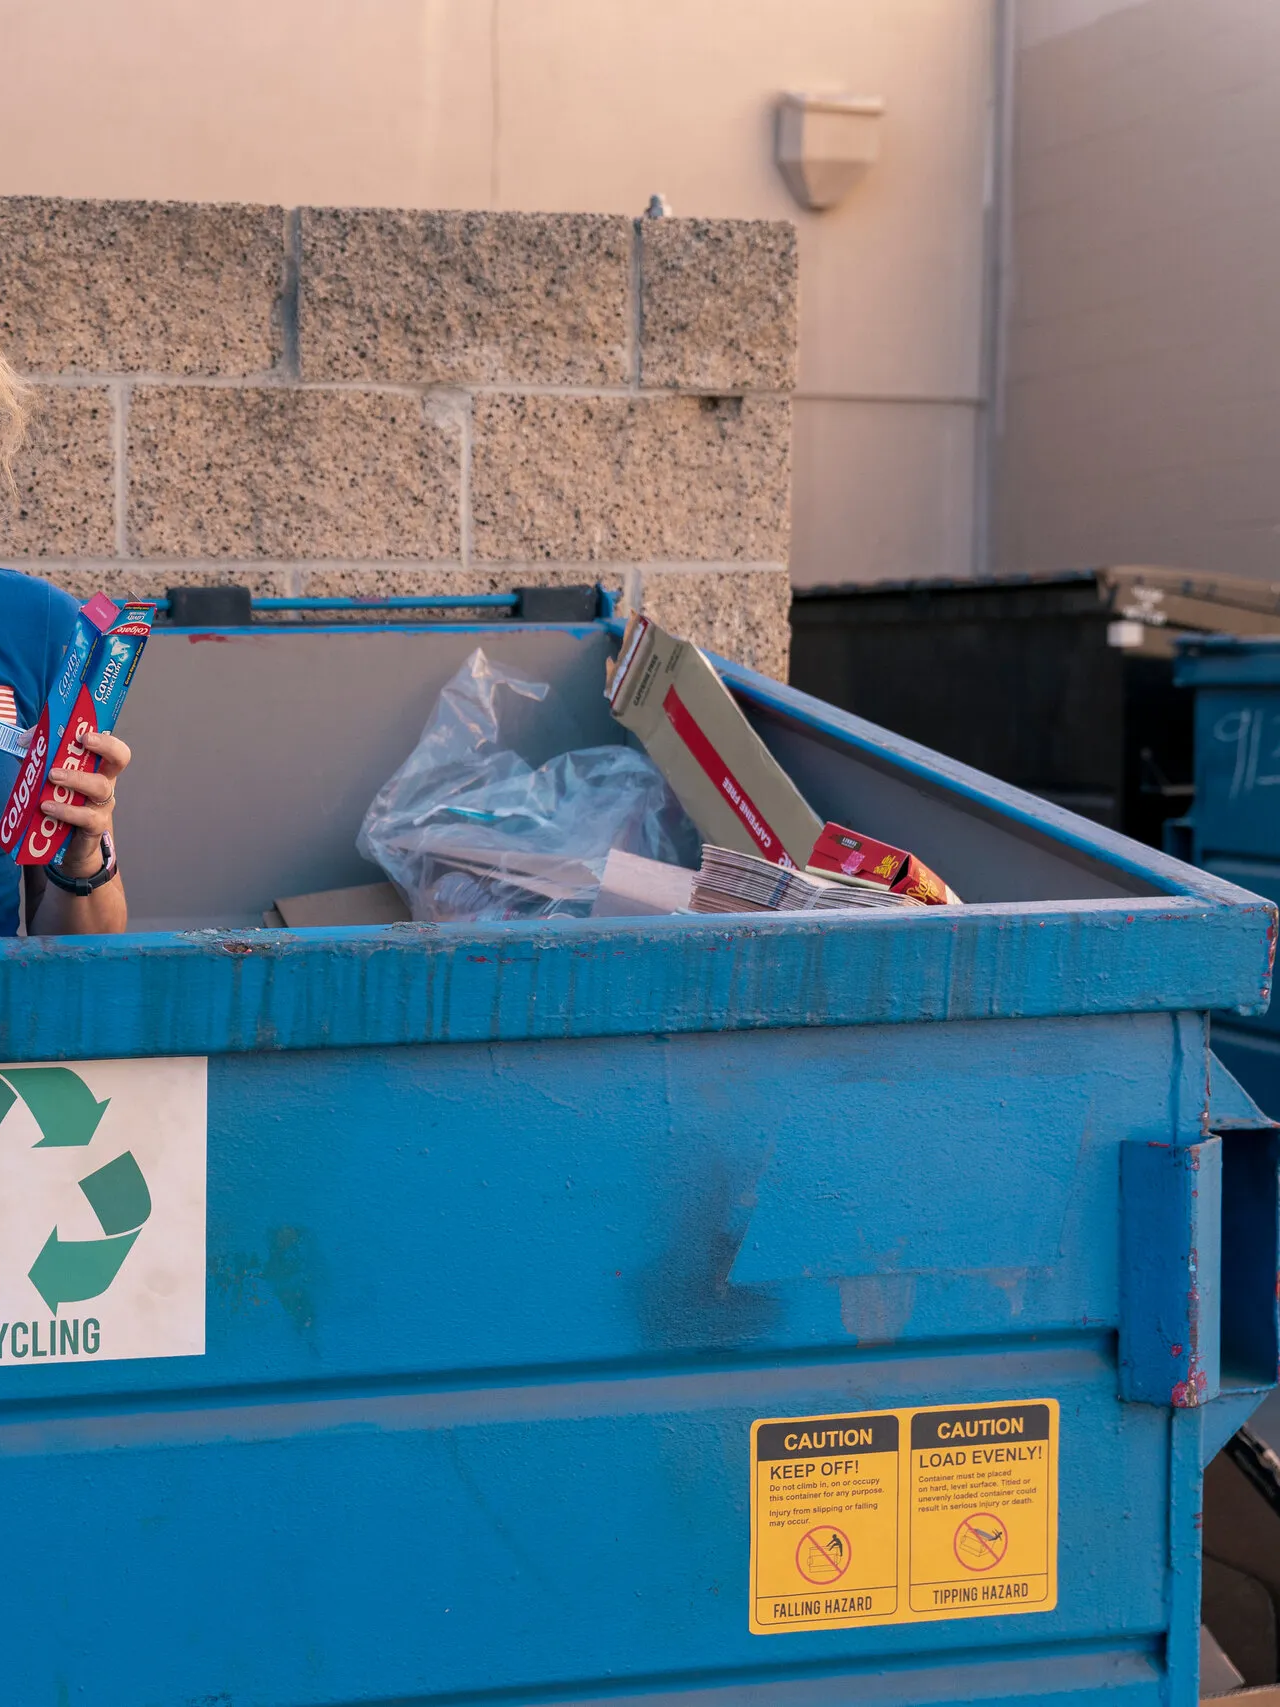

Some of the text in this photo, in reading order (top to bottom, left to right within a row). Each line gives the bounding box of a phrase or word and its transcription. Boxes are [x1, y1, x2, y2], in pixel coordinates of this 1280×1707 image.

[59, 648, 77, 696] Cavity
[94, 658, 118, 702] Cavity
[101, 662, 122, 704] Protection
[0, 736, 46, 844] Colgate
[28, 721, 89, 858] Cogate
[722, 776, 772, 848] CAFFEINE FREE
[784, 1428, 873, 1451] CAUTION
[937, 1417, 1024, 1440] CAUTION
[919, 1446, 1042, 1468] LOAD EVENLY!
[770, 1460, 859, 1480] KEEP OFF!
[918, 1474, 954, 1482] Container
[987, 1470, 1012, 1479] placed
[769, 1487, 885, 1502] this container for any purpose.
[782, 1483, 795, 1491] not
[796, 1481, 817, 1490] climb
[852, 1478, 880, 1487] occupy
[918, 1487, 1037, 1503] unevenly loaded container could
[769, 1509, 793, 1518] Injury
[793, 1507, 811, 1515] from
[812, 1505, 843, 1514] slipping
[854, 1502, 878, 1511] falling
[918, 1504, 939, 1512] result
[950, 1501, 977, 1510] serious
[769, 1518, 810, 1528] may occur.
[933, 1583, 1028, 1604] TIPPING HAZARD
[774, 1596, 872, 1618] FALLING HAZARD
